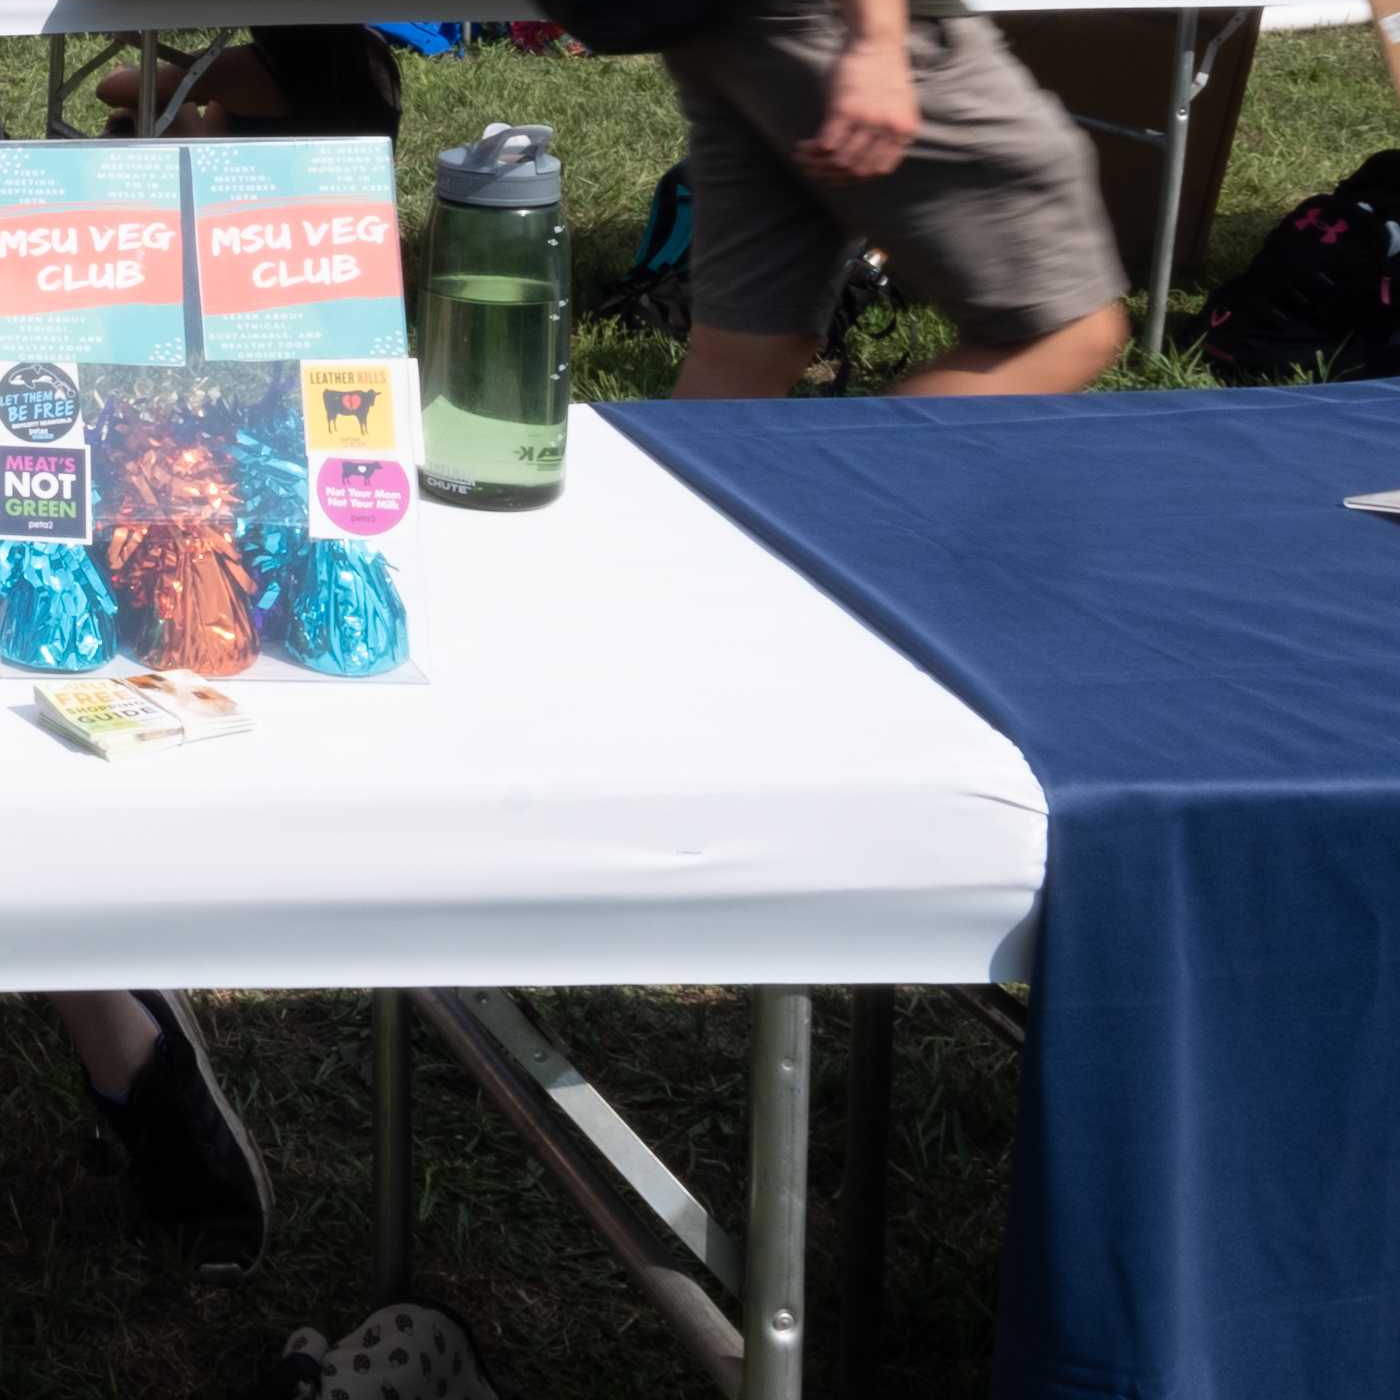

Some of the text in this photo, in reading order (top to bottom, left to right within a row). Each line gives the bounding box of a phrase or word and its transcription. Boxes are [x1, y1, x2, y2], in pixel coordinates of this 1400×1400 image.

[13, 169, 46, 177] FIRST
[107, 191, 147, 199] WELLS
[210, 184, 276, 192] SEPTEMBER
[319, 184, 357, 192] WELLS
[88, 222, 177, 252] VEG
[211, 215, 391, 257] MSU VEG
[37, 259, 146, 292] CLUB
[252, 253, 362, 289] CLUB
[79, 335, 103, 343] AND
[278, 341, 311, 349] FOOD
[59, 344, 92, 352] FOOD
[309, 370, 387, 385] LEATHER KILLS
[0, 390, 54, 407] LET THEM
[8, 399, 75, 423] BE FREE
[5, 455, 76, 474] MEAT'S
[4, 471, 77, 499] NOT
[426, 476, 468, 495] CHUTE
[325, 486, 401, 500] Not Your Mom
[5, 498, 77, 518] GREEN
[327, 497, 400, 510] Not Your Milk
[28, 520, 54, 530] peta2
[350, 515, 376, 525] peta2
[53, 690, 136, 706] FREE
[66, 700, 146, 715] SHOPPING
[76, 706, 158, 724] GUIDE
